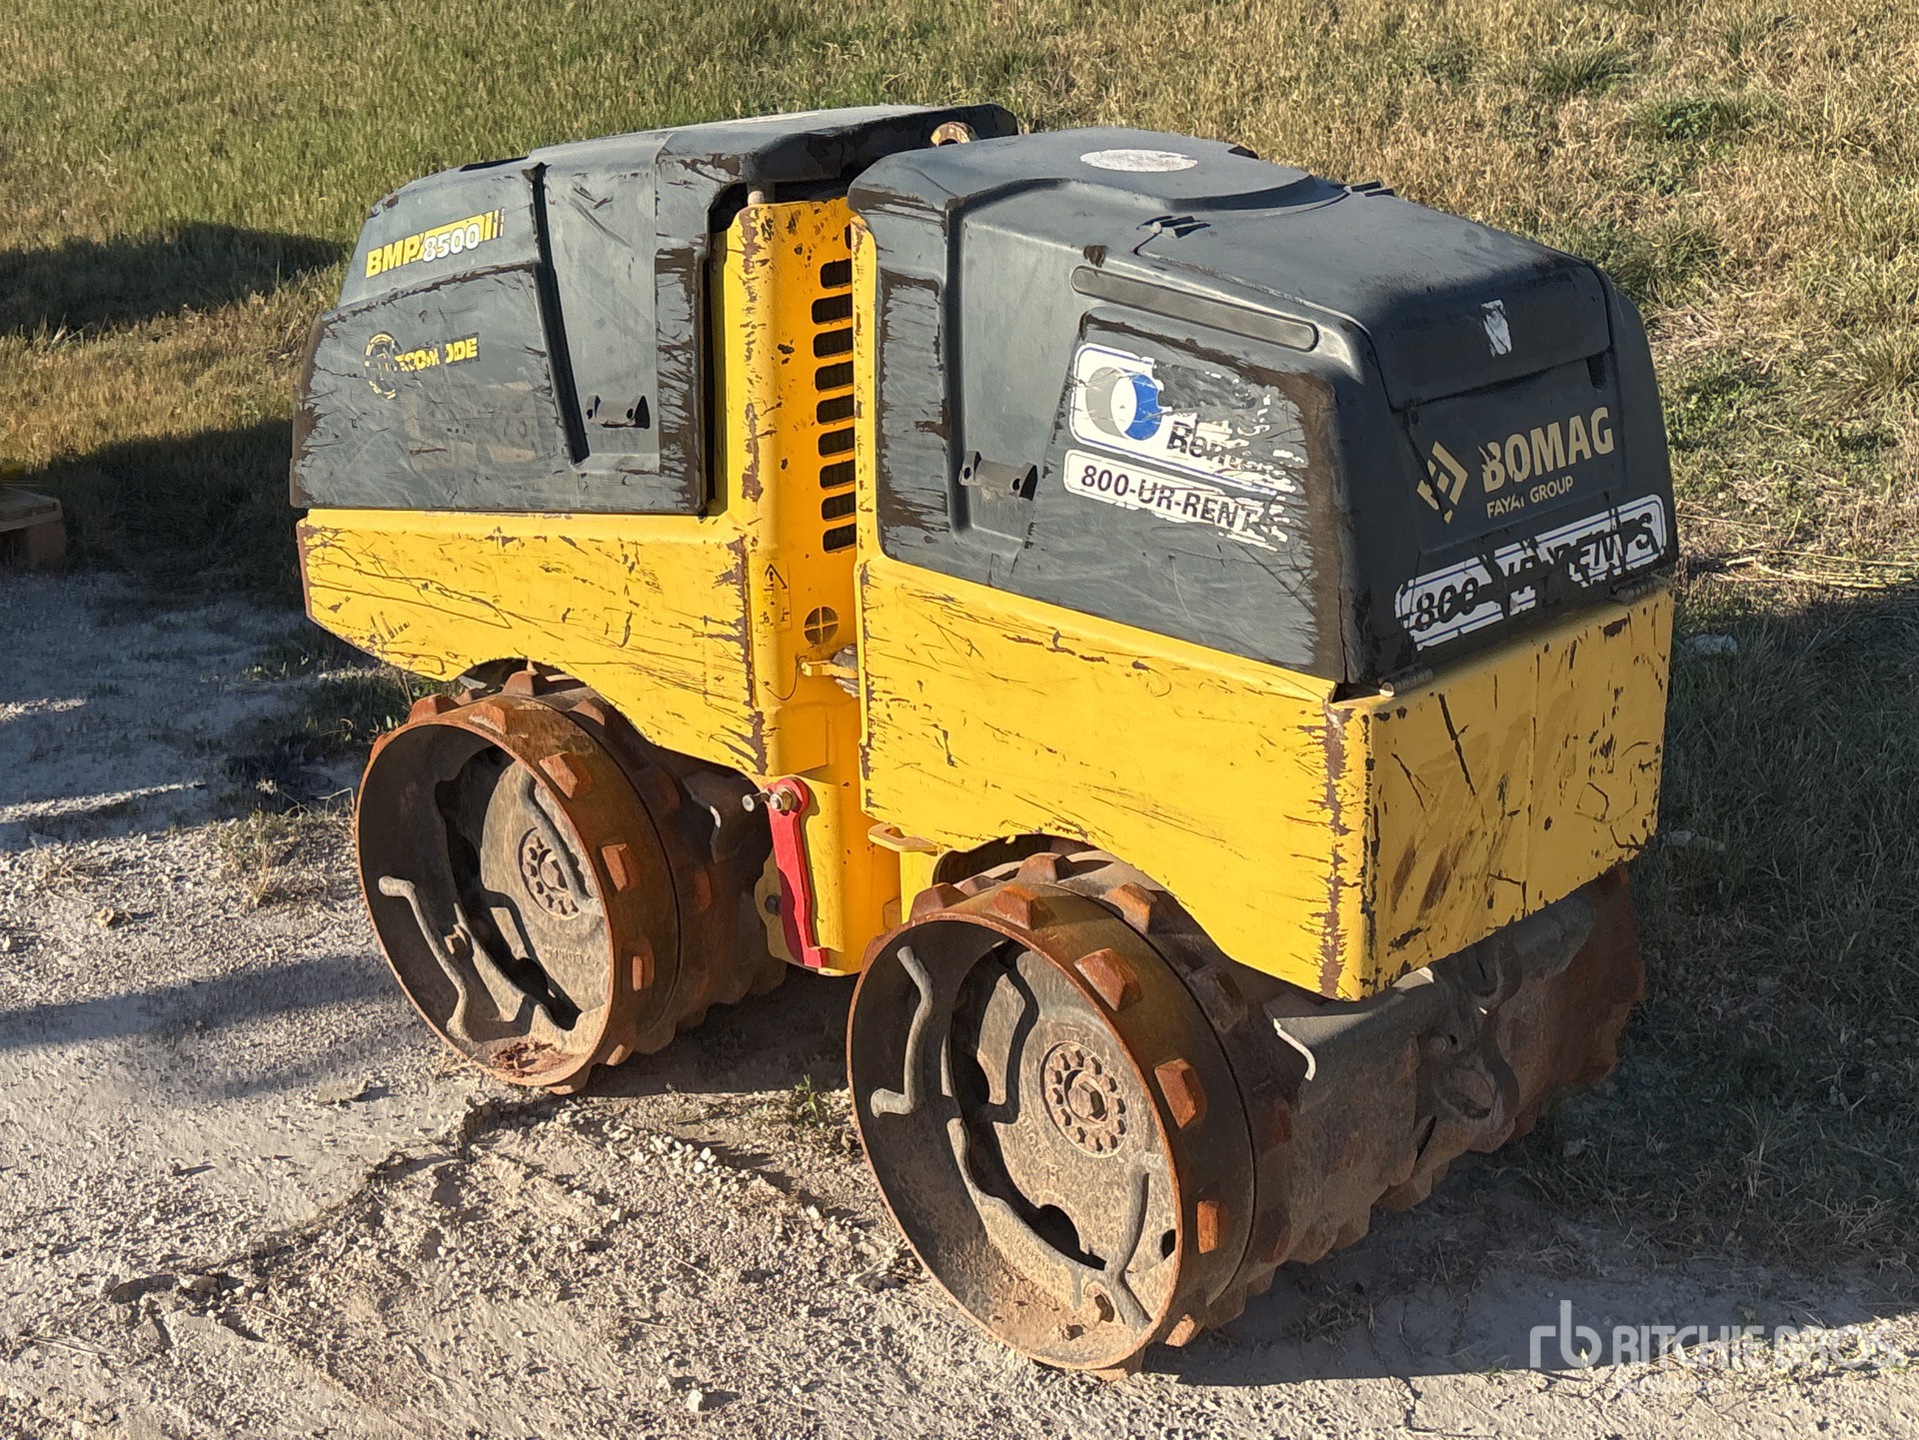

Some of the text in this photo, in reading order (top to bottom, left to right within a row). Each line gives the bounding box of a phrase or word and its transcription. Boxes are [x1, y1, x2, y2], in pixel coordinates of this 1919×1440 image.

[422, 223, 480, 263] 8500
[1478, 407, 1614, 493] BOMAG
[1530, 475, 1574, 503] GROUP
